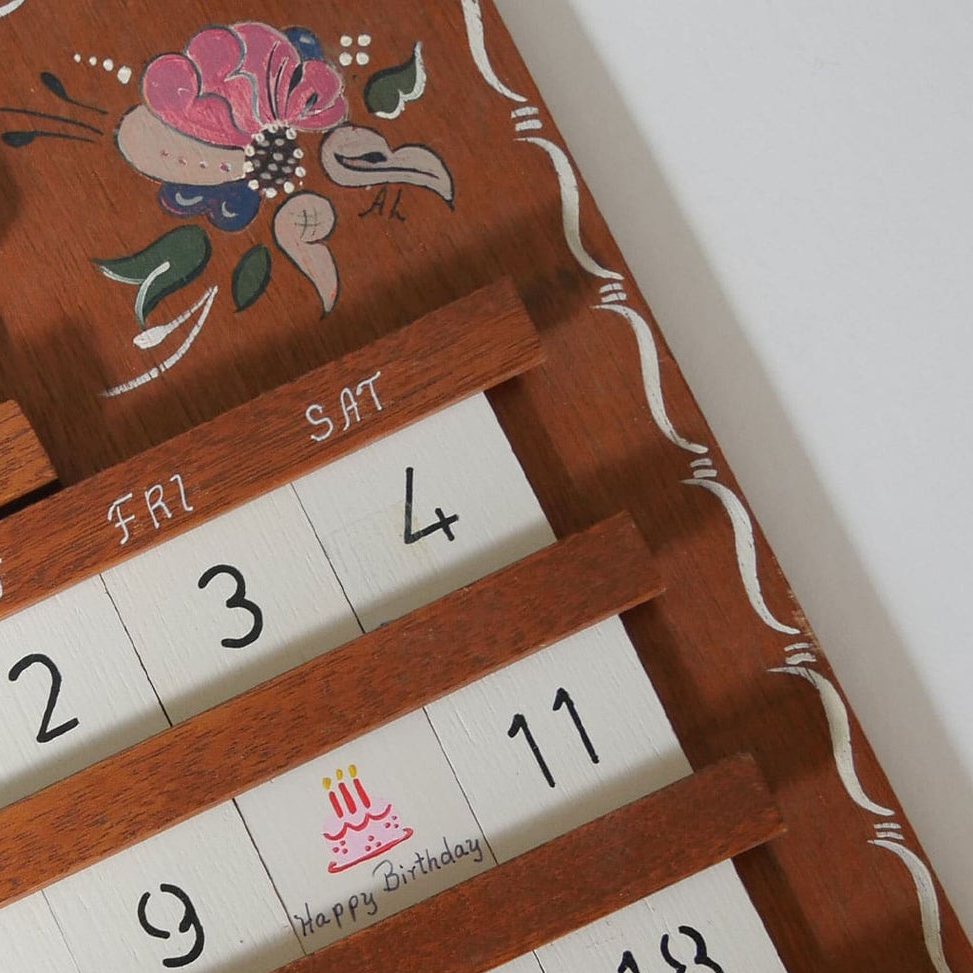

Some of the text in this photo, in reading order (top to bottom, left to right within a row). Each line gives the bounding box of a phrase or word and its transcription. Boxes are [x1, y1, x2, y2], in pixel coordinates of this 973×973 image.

[107, 474, 193, 545] FRI
[305, 371, 383, 442] SAT
[8, 653, 80, 744] 2
[197, 564, 264, 649] 3
[404, 466, 459, 545] 4
[507, 687, 600, 788] 11
[137, 883, 204, 967] 9
[294, 836, 483, 937] Happy Birthday
